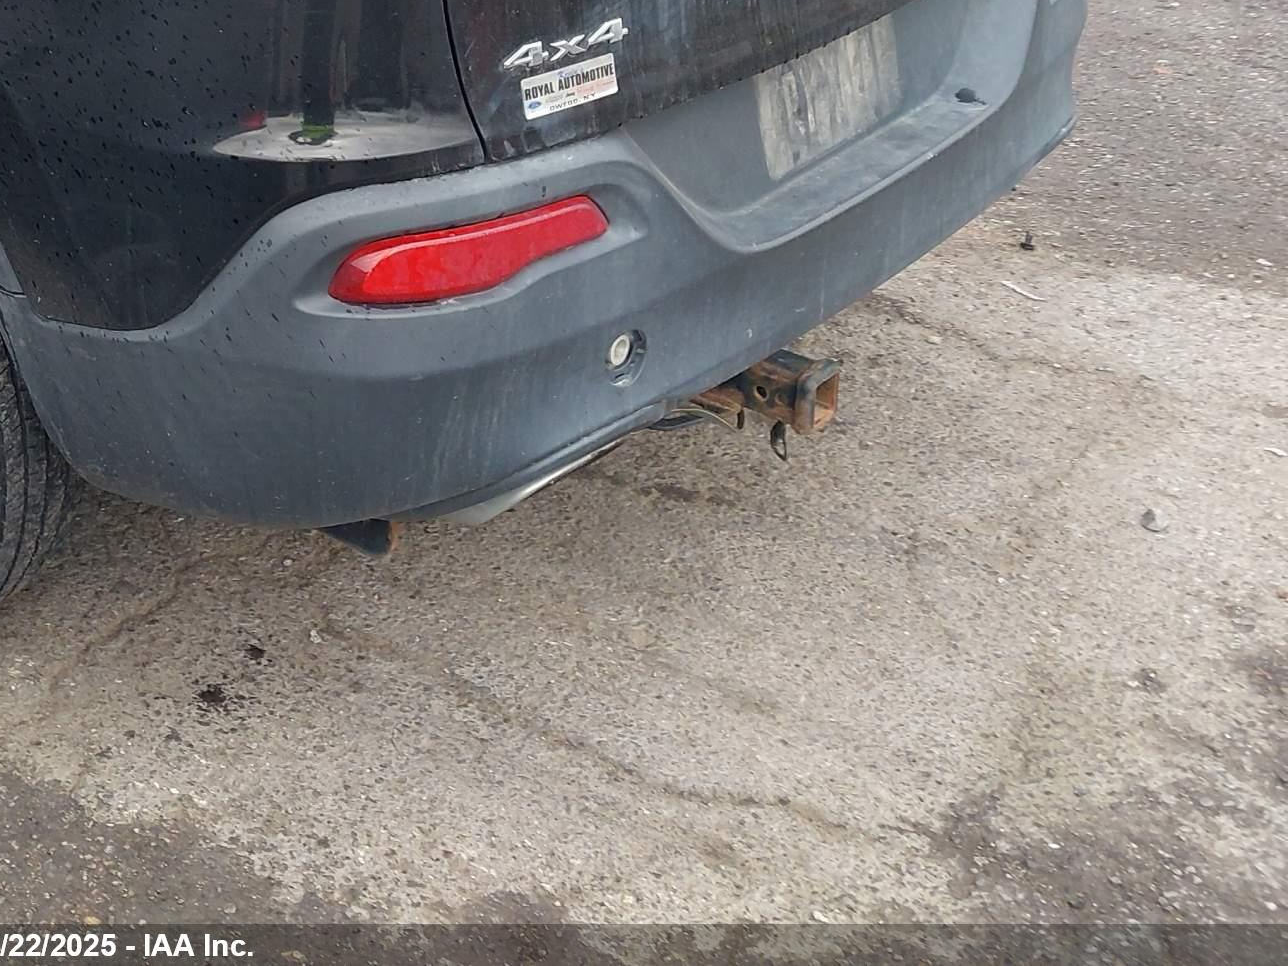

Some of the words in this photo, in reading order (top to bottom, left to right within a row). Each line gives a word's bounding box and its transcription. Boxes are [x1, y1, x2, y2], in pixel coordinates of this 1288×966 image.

[503, 17, 629, 70] 4x4
[524, 81, 555, 101] ROYAL
[558, 63, 614, 91] AUTOMOTIVE
